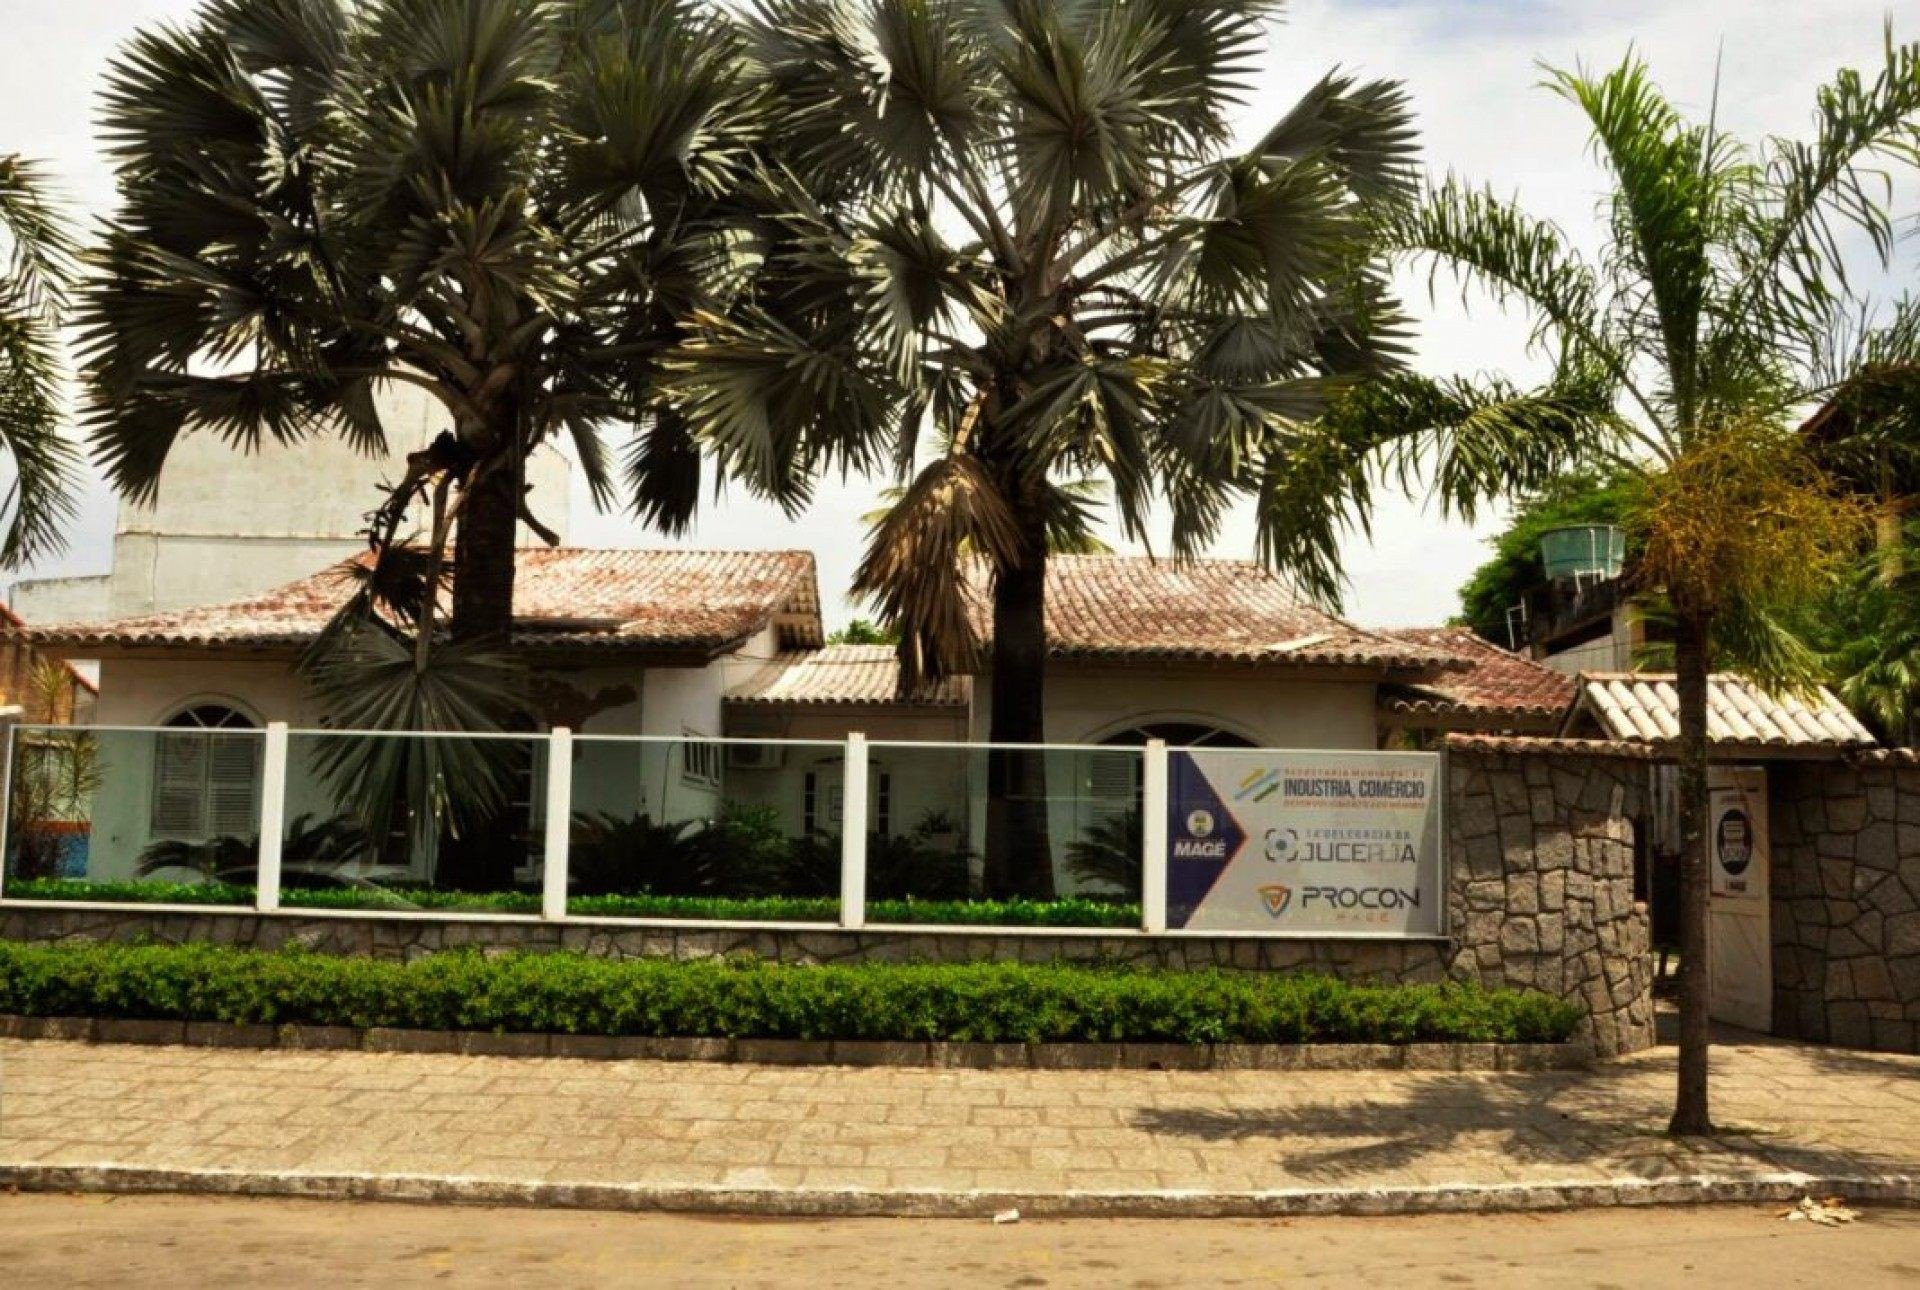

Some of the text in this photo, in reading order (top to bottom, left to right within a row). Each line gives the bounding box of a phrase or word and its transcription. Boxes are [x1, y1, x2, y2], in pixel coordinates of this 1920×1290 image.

[1174, 840, 1226, 858] MAGÉ
[1300, 842, 1416, 864] JUCERJA
[1302, 886, 1422, 909] PROCON
